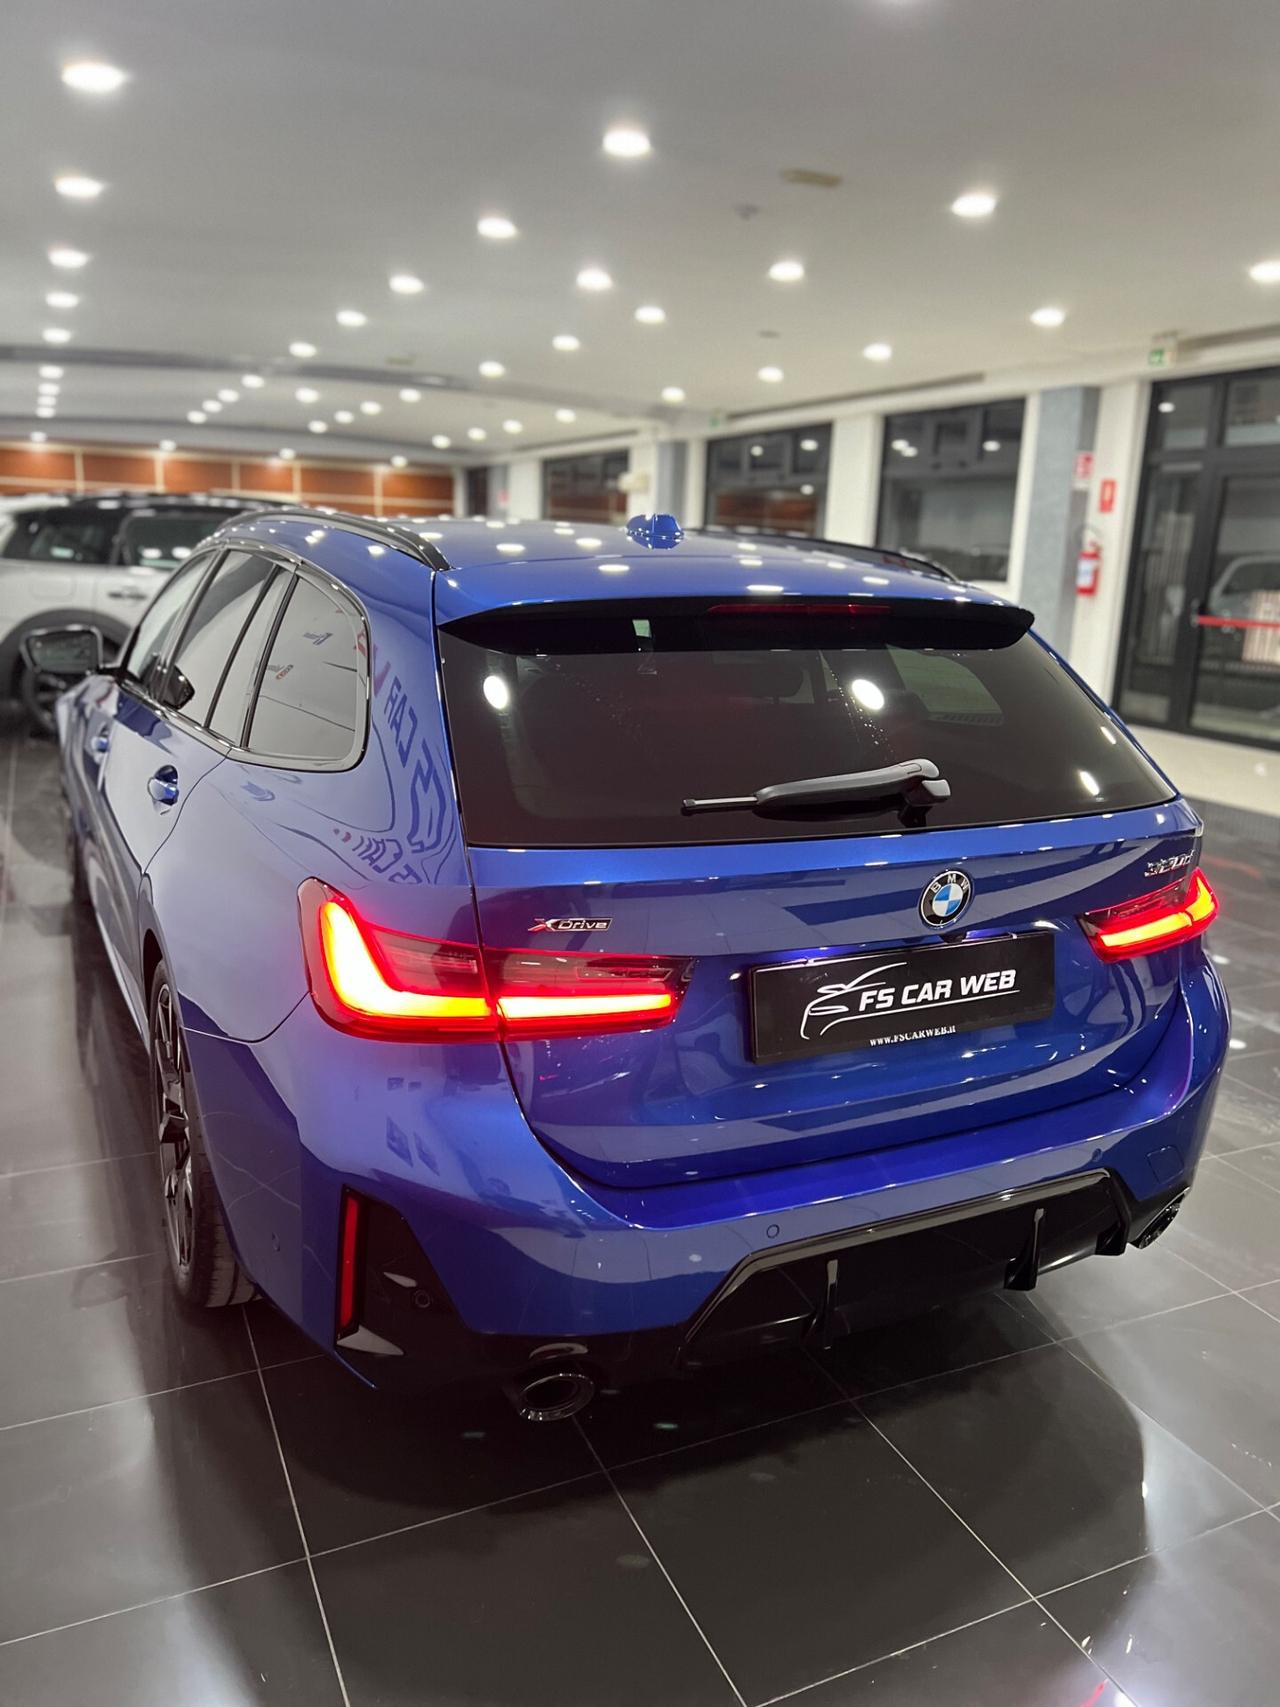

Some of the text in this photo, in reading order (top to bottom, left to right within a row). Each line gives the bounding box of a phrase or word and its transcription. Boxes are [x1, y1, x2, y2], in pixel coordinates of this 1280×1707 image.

[930, 873, 970, 893] BMW
[858, 969, 1017, 1012] FS CAR WEB
